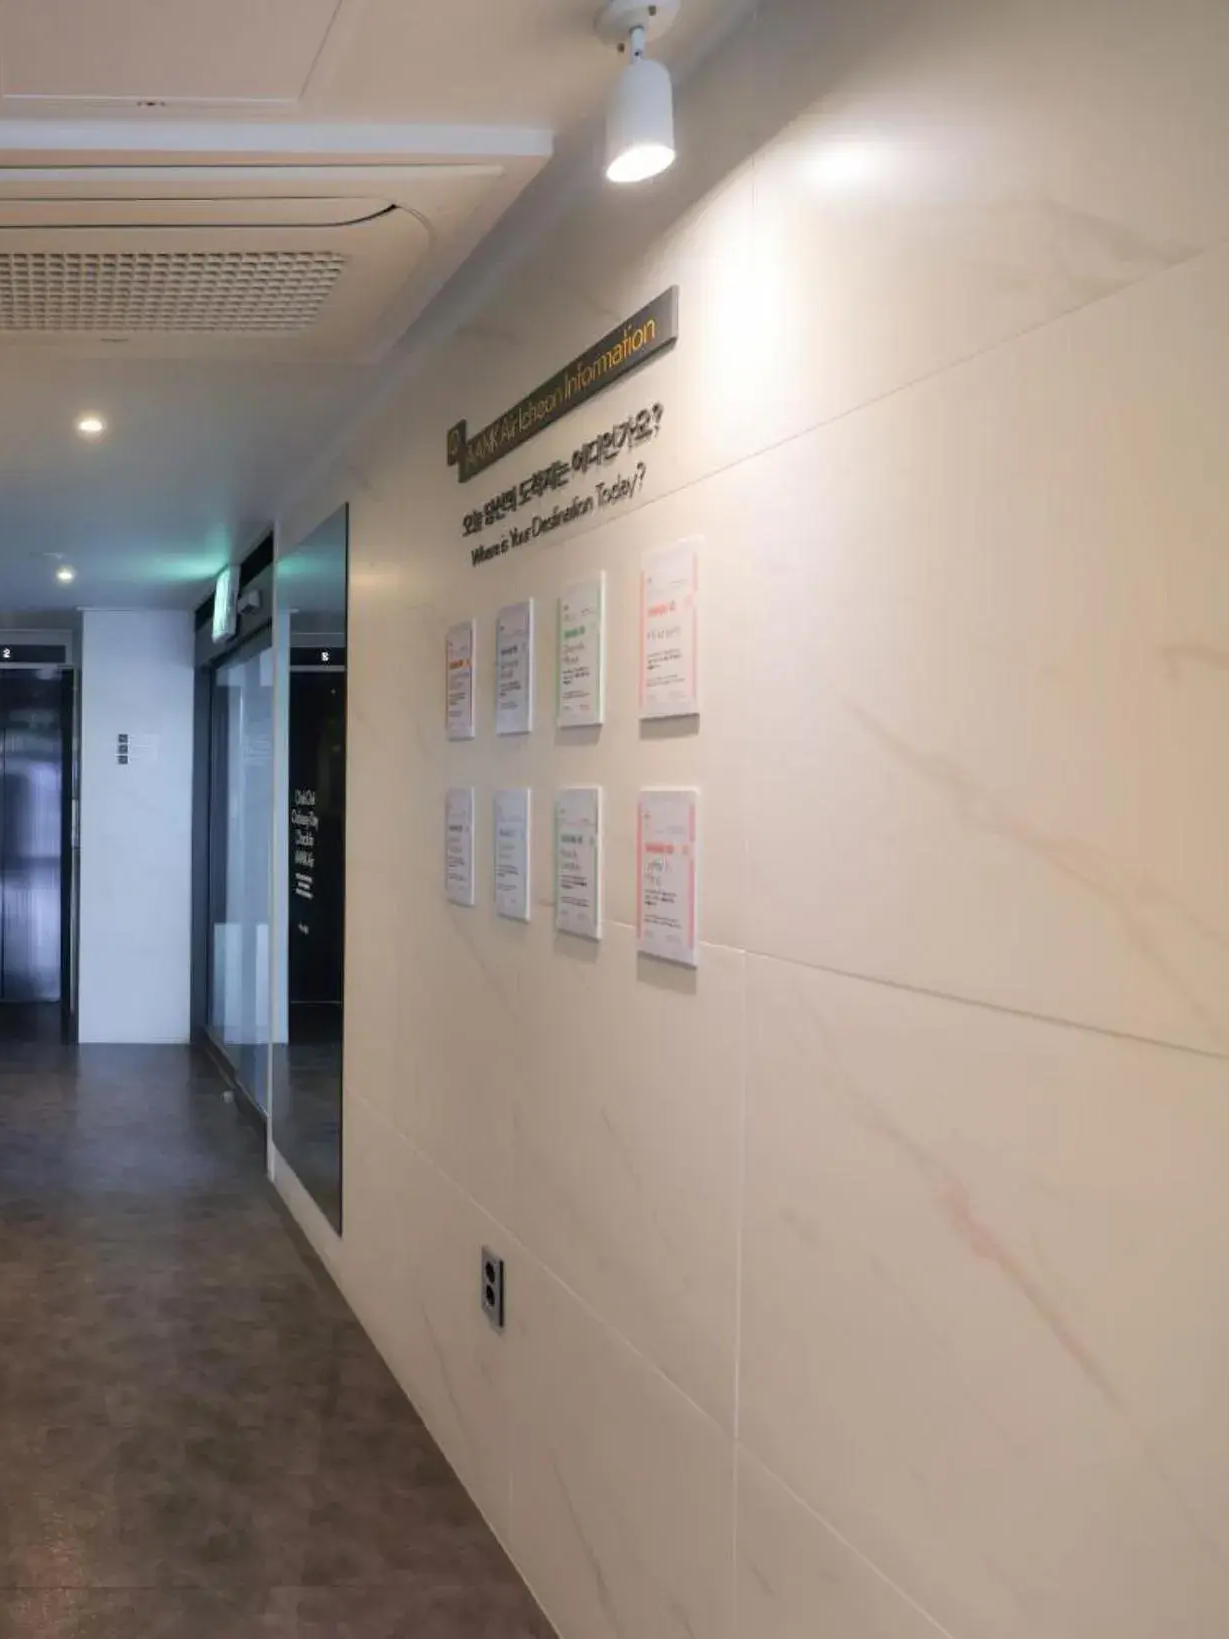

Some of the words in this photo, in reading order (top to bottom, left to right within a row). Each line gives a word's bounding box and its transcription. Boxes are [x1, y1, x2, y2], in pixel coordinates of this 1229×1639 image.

[563, 318, 656, 399] Information
[518, 460, 570, 506] 도착지는
[571, 402, 664, 474] 어디인가요?
[595, 461, 647, 507] Today?
[3, 648, 11, 658] 2
